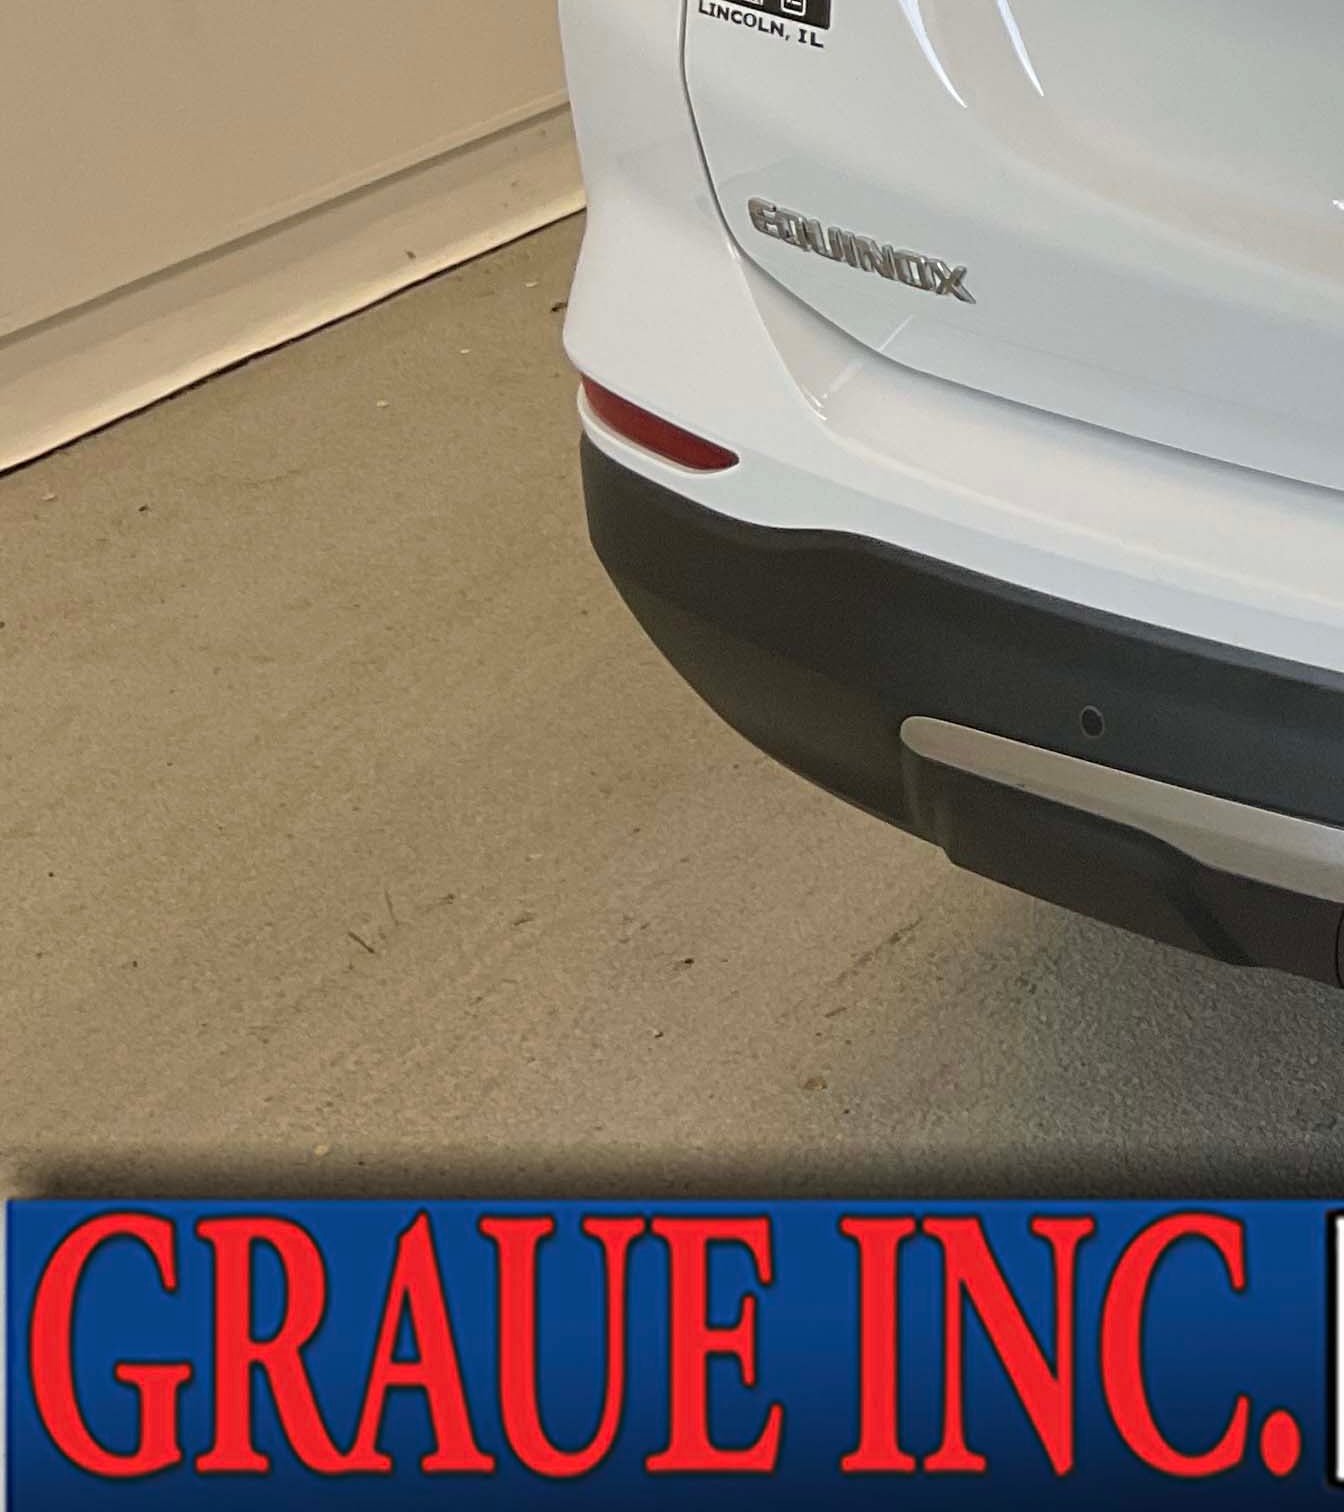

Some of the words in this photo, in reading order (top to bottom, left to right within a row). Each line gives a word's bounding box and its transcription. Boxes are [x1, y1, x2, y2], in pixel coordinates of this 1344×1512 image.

[698, 0, 790, 41] LINCOLN,
[798, 28, 824, 48] IL
[748, 197, 976, 305] EQUINOX
